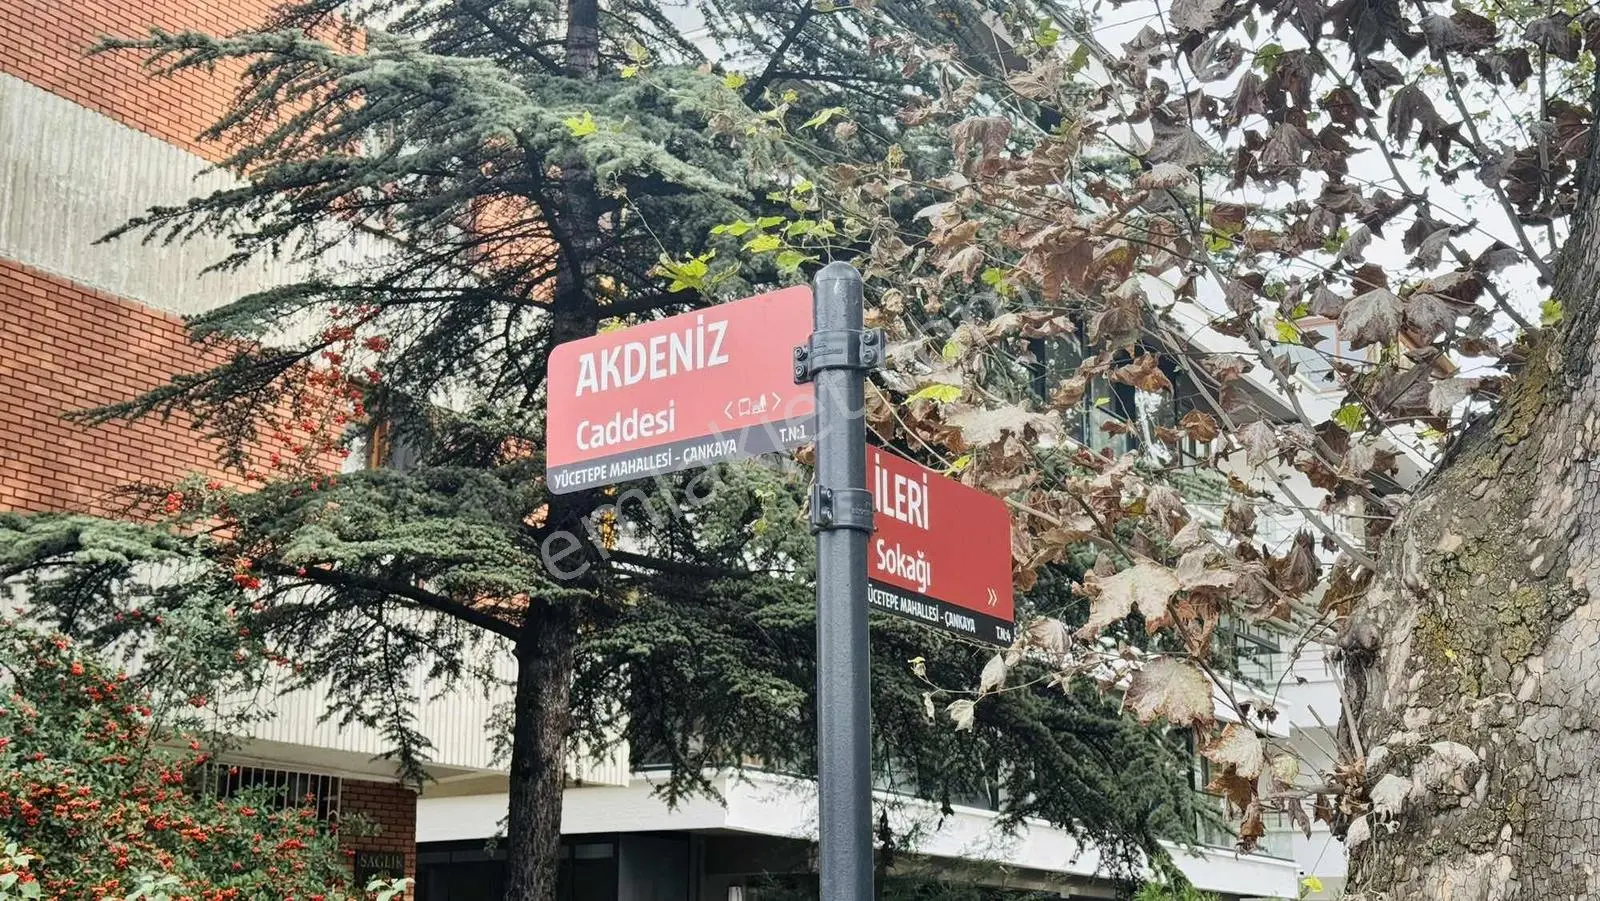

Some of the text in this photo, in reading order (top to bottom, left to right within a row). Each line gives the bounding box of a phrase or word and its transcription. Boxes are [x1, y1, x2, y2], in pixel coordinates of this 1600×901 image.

[575, 314, 729, 397] AKDENİZ
[576, 399, 676, 450] Caddesi
[778, 424, 807, 443] T.N:1
[554, 467, 607, 489] YÜCETEPE
[609, 448, 672, 479] MAHALLESİ
[683, 438, 737, 467] ÇANKAYA
[874, 453, 929, 530] İLERİ
[876, 538, 931, 593] Sokağı
[867, 583, 899, 611] ÜCETEPE
[900, 596, 939, 623] MAHALLESİ
[944, 610, 976, 634] ÇANKAYA
